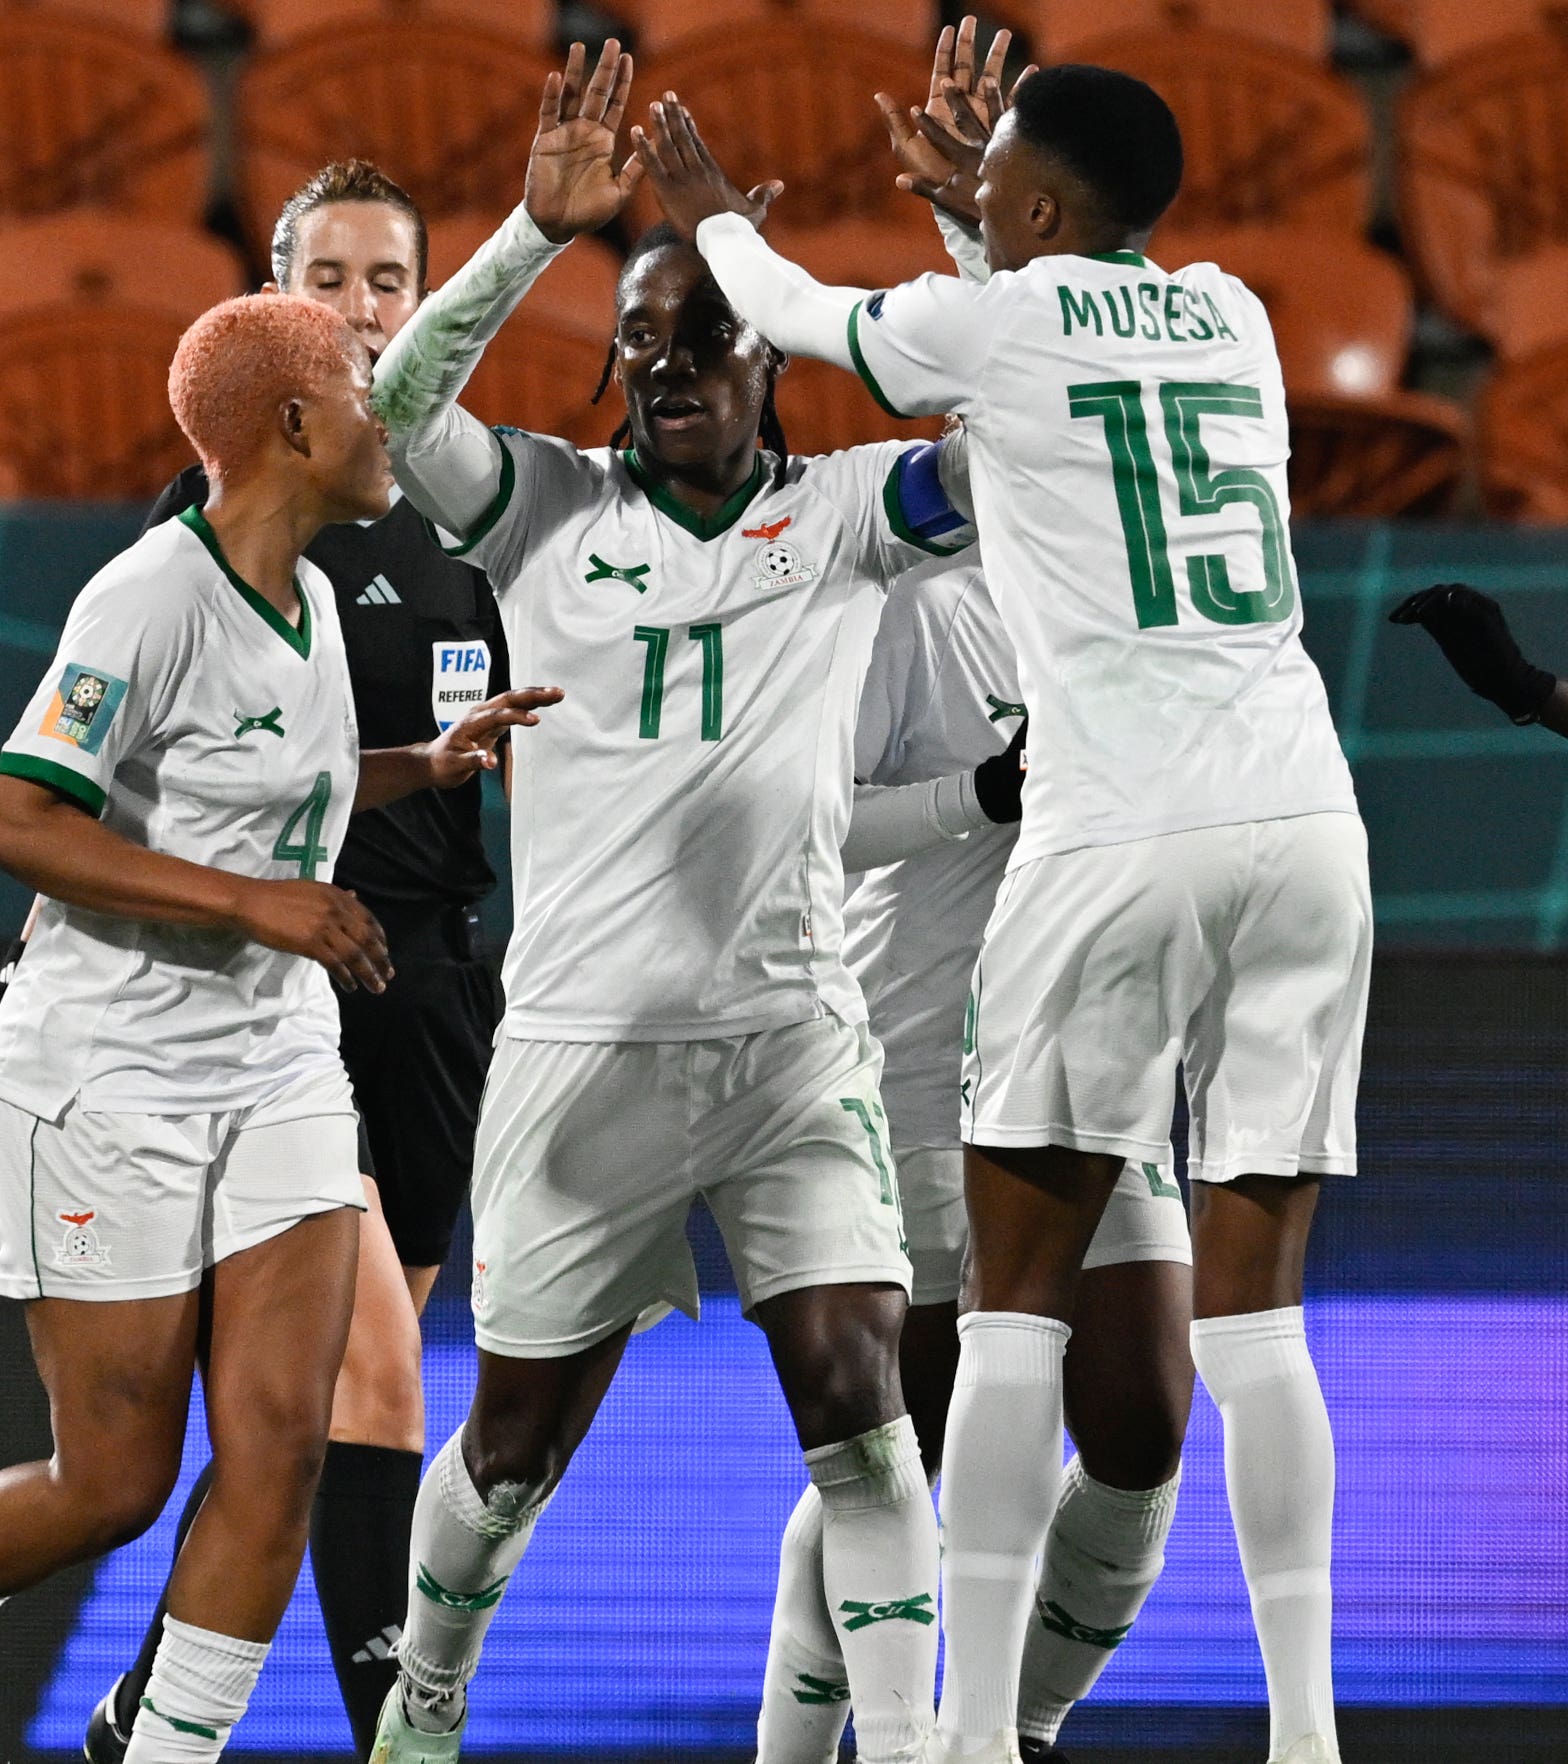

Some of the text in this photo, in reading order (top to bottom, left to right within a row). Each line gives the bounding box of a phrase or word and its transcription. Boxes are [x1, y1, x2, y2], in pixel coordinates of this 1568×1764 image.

[1057, 283, 1238, 341] MUSESA
[1067, 380, 1294, 629] 15
[438, 689, 483, 703] REFEREE
[440, 648, 486, 673] FIFA
[633, 623, 723, 741] 11
[272, 771, 332, 881] 4
